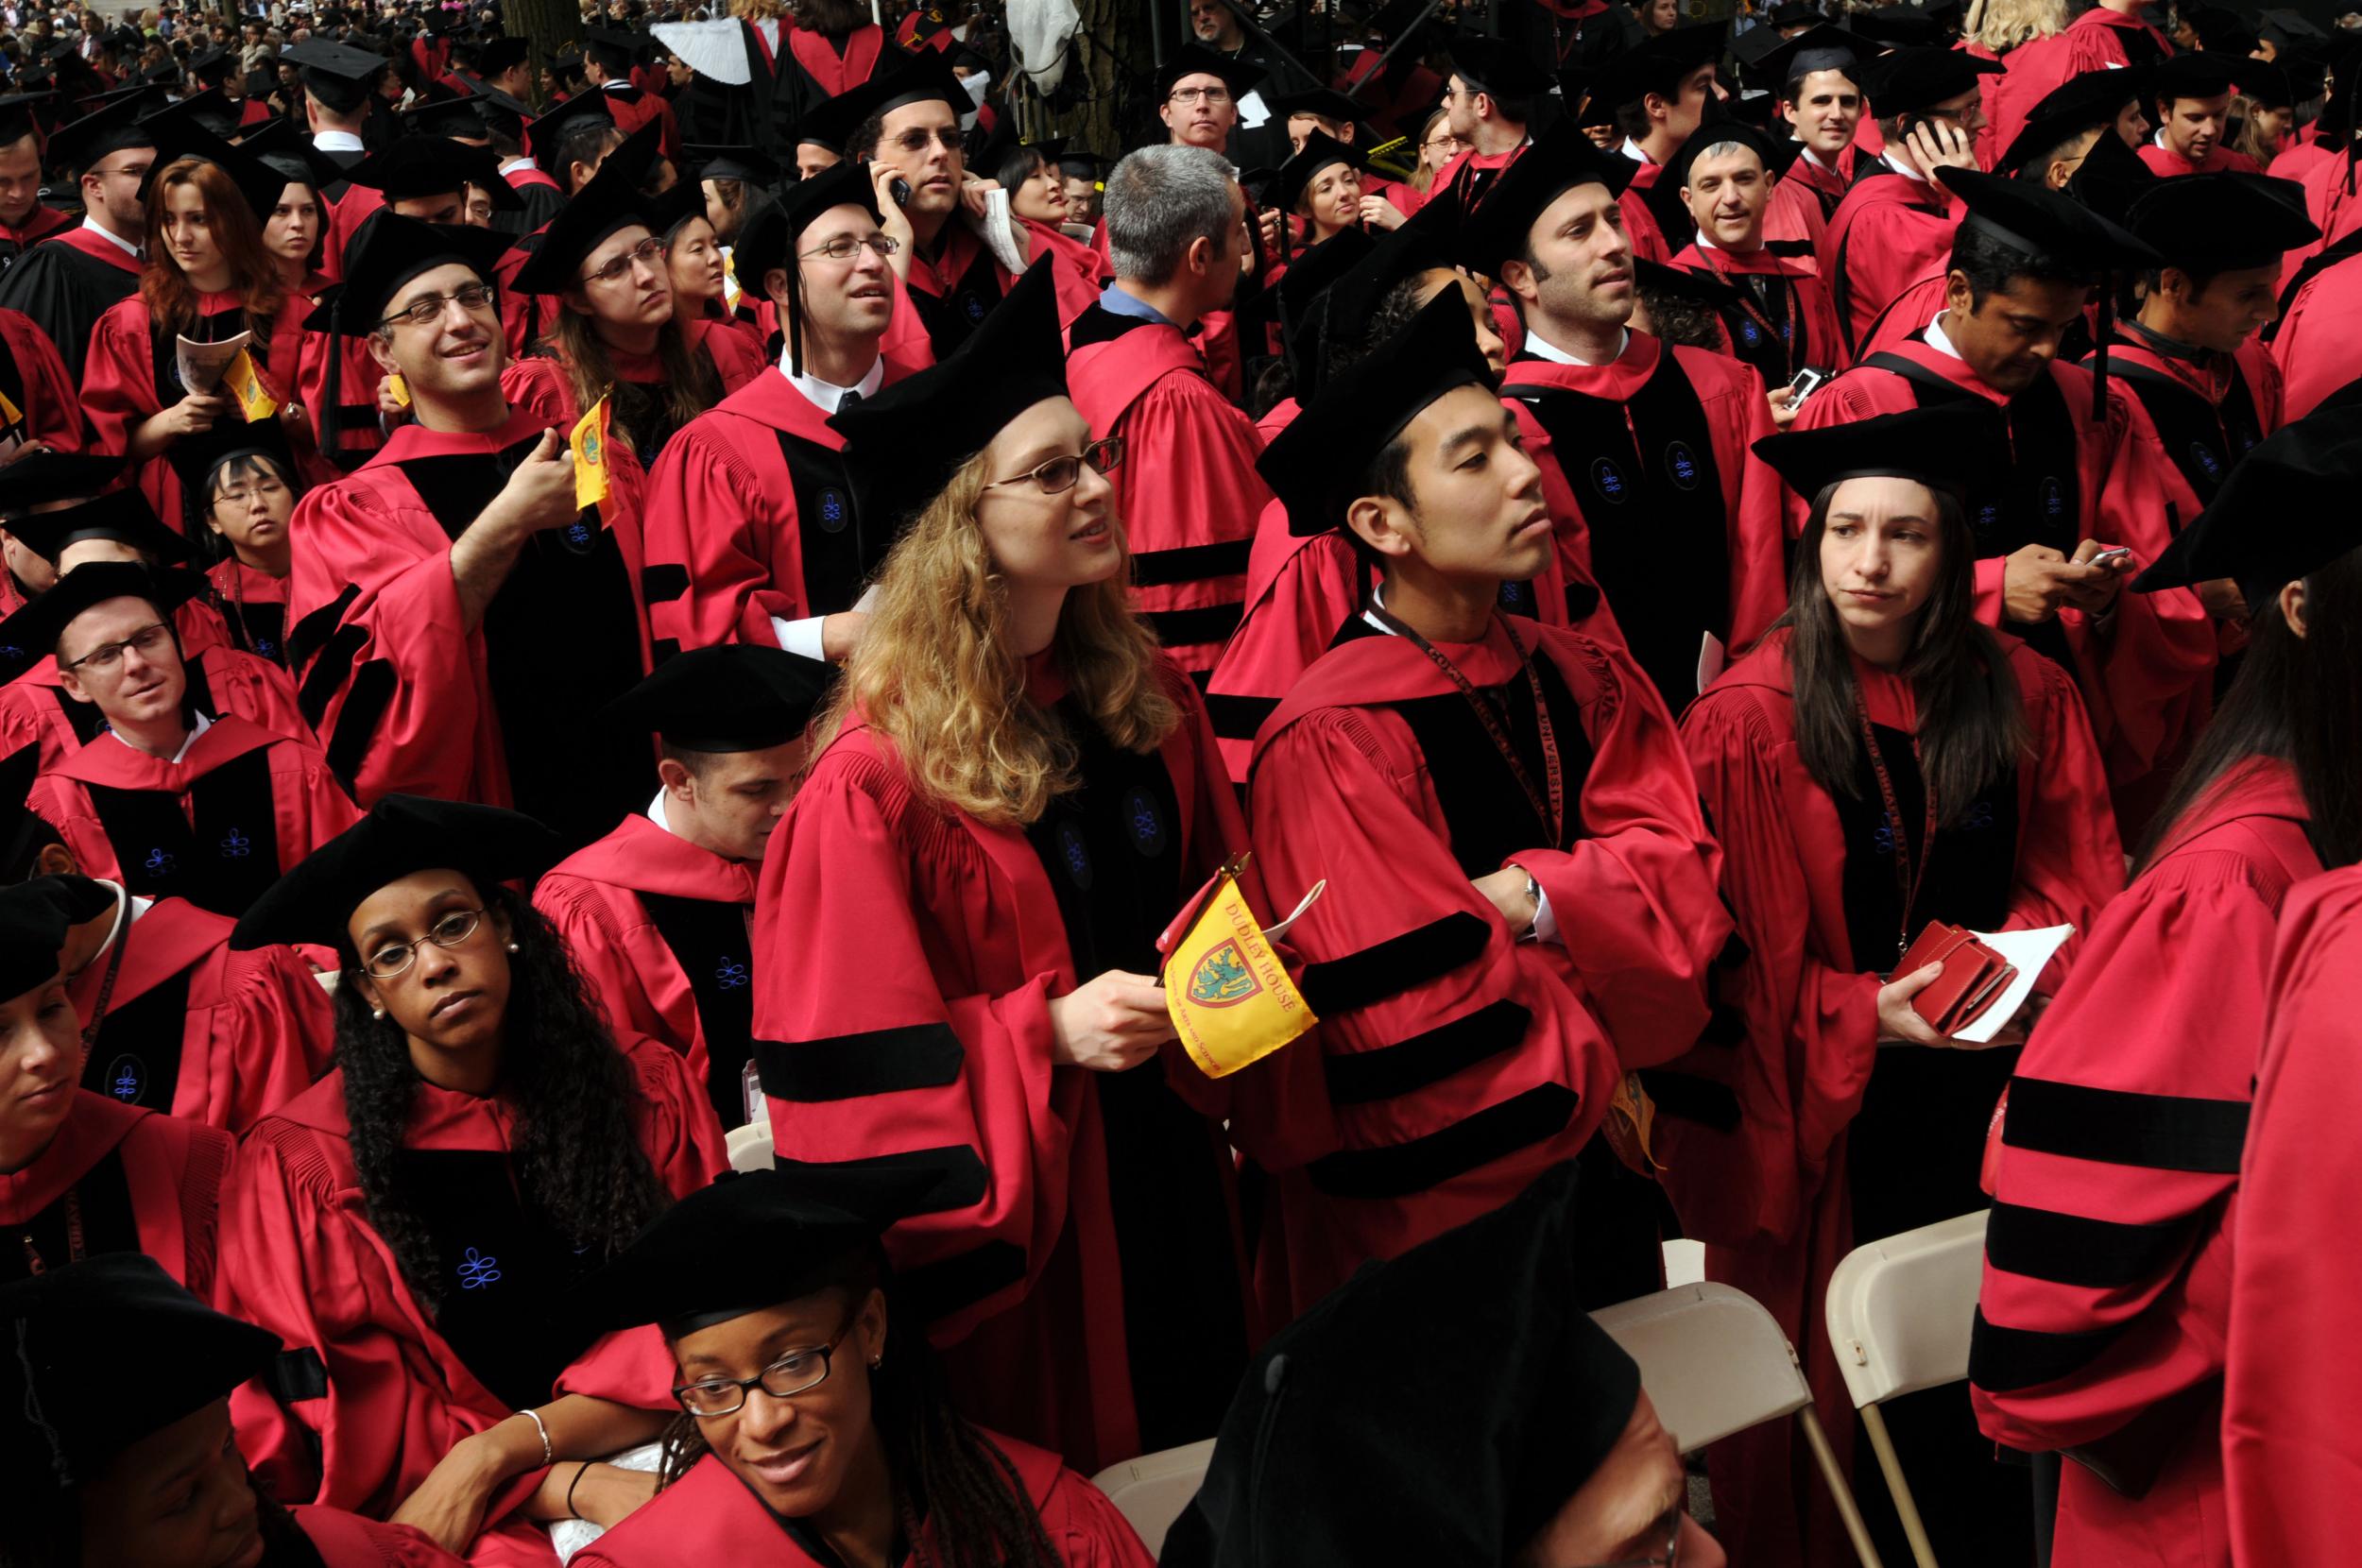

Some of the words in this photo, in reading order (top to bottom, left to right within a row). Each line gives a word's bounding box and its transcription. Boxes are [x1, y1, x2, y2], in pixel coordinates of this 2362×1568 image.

[1540, 715, 1561, 817] UNIVERSITY
[1225, 903, 1266, 961] DUDLEY
[1258, 962, 1296, 1013] HOUSE
